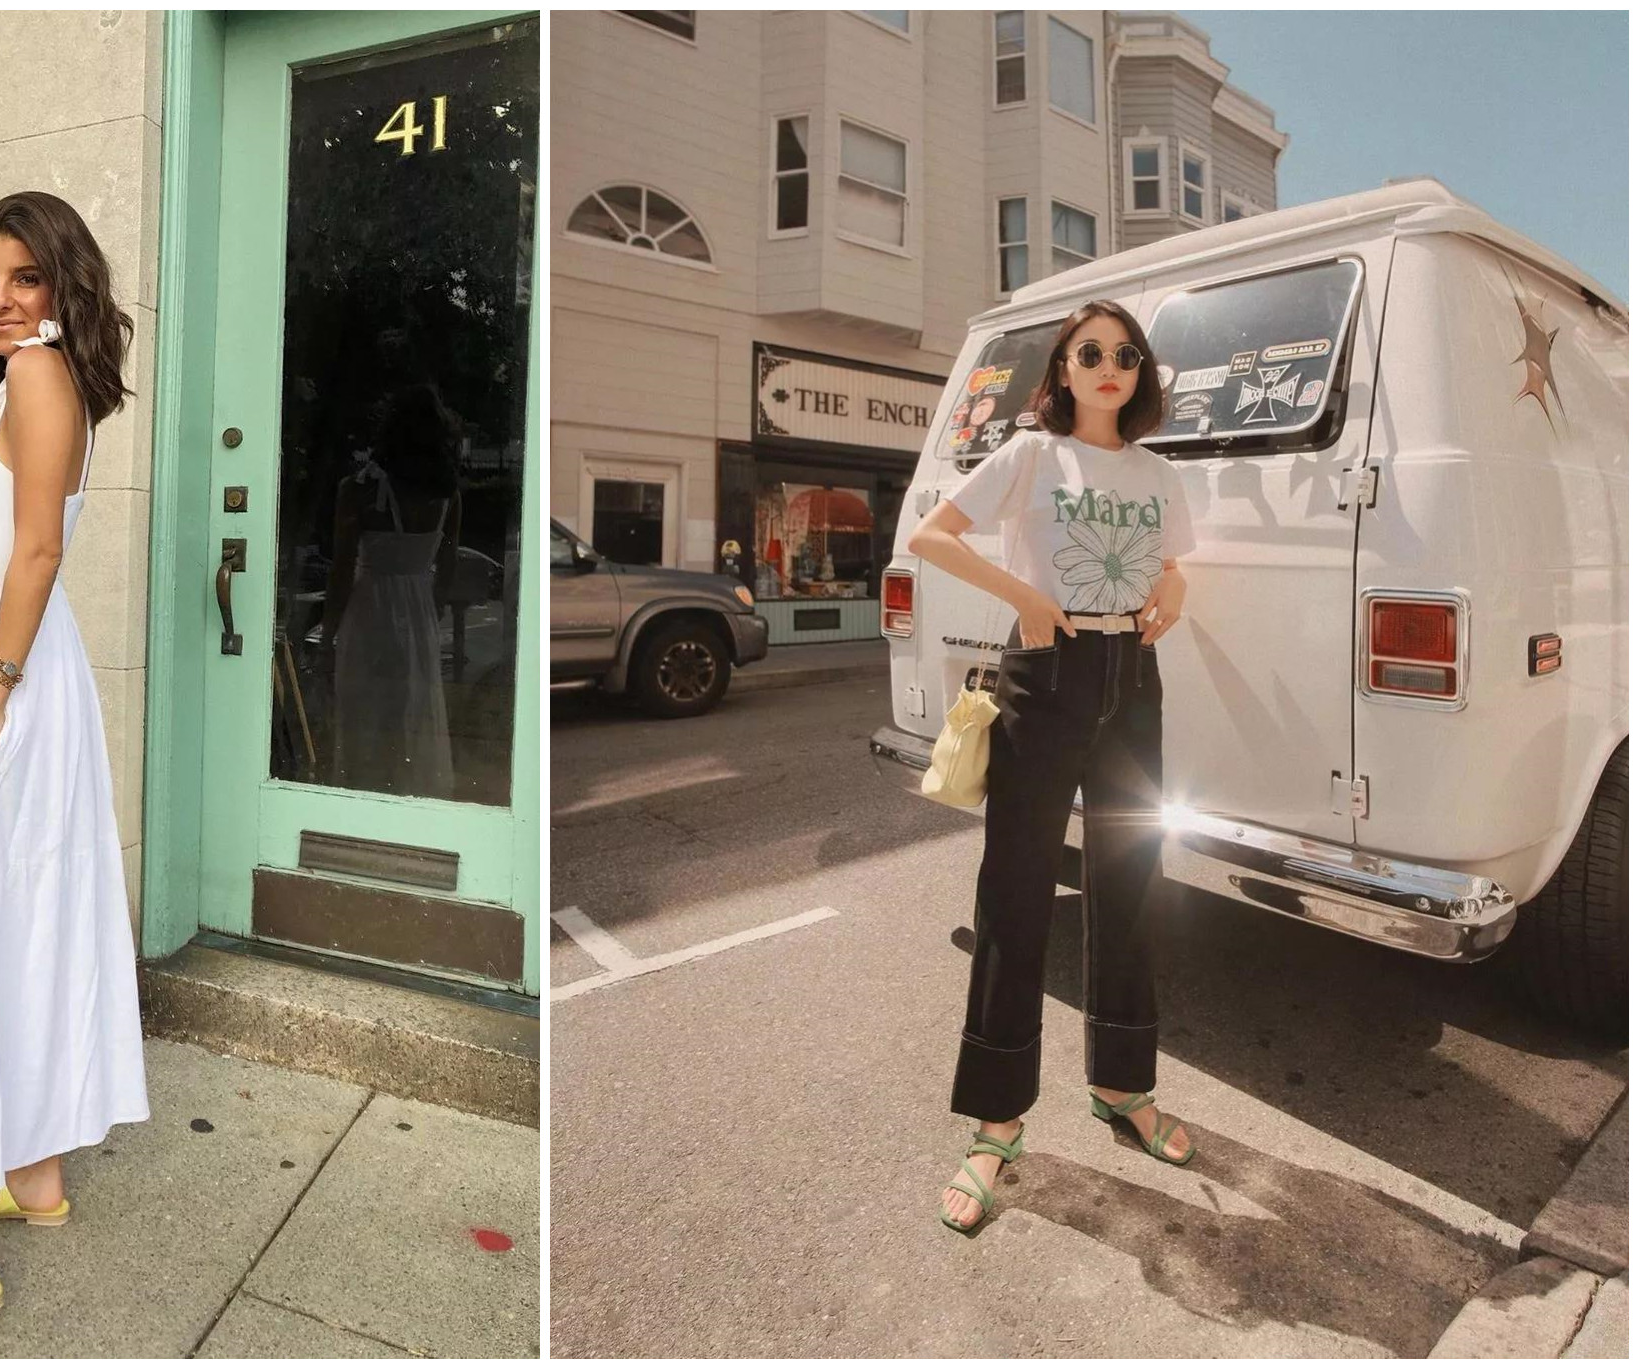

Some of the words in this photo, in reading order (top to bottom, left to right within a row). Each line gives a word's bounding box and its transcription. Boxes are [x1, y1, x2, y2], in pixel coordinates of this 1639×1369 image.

[373, 94, 449, 156] 41
[794, 388, 849, 417] THE
[1051, 487, 1169, 528] Mard
